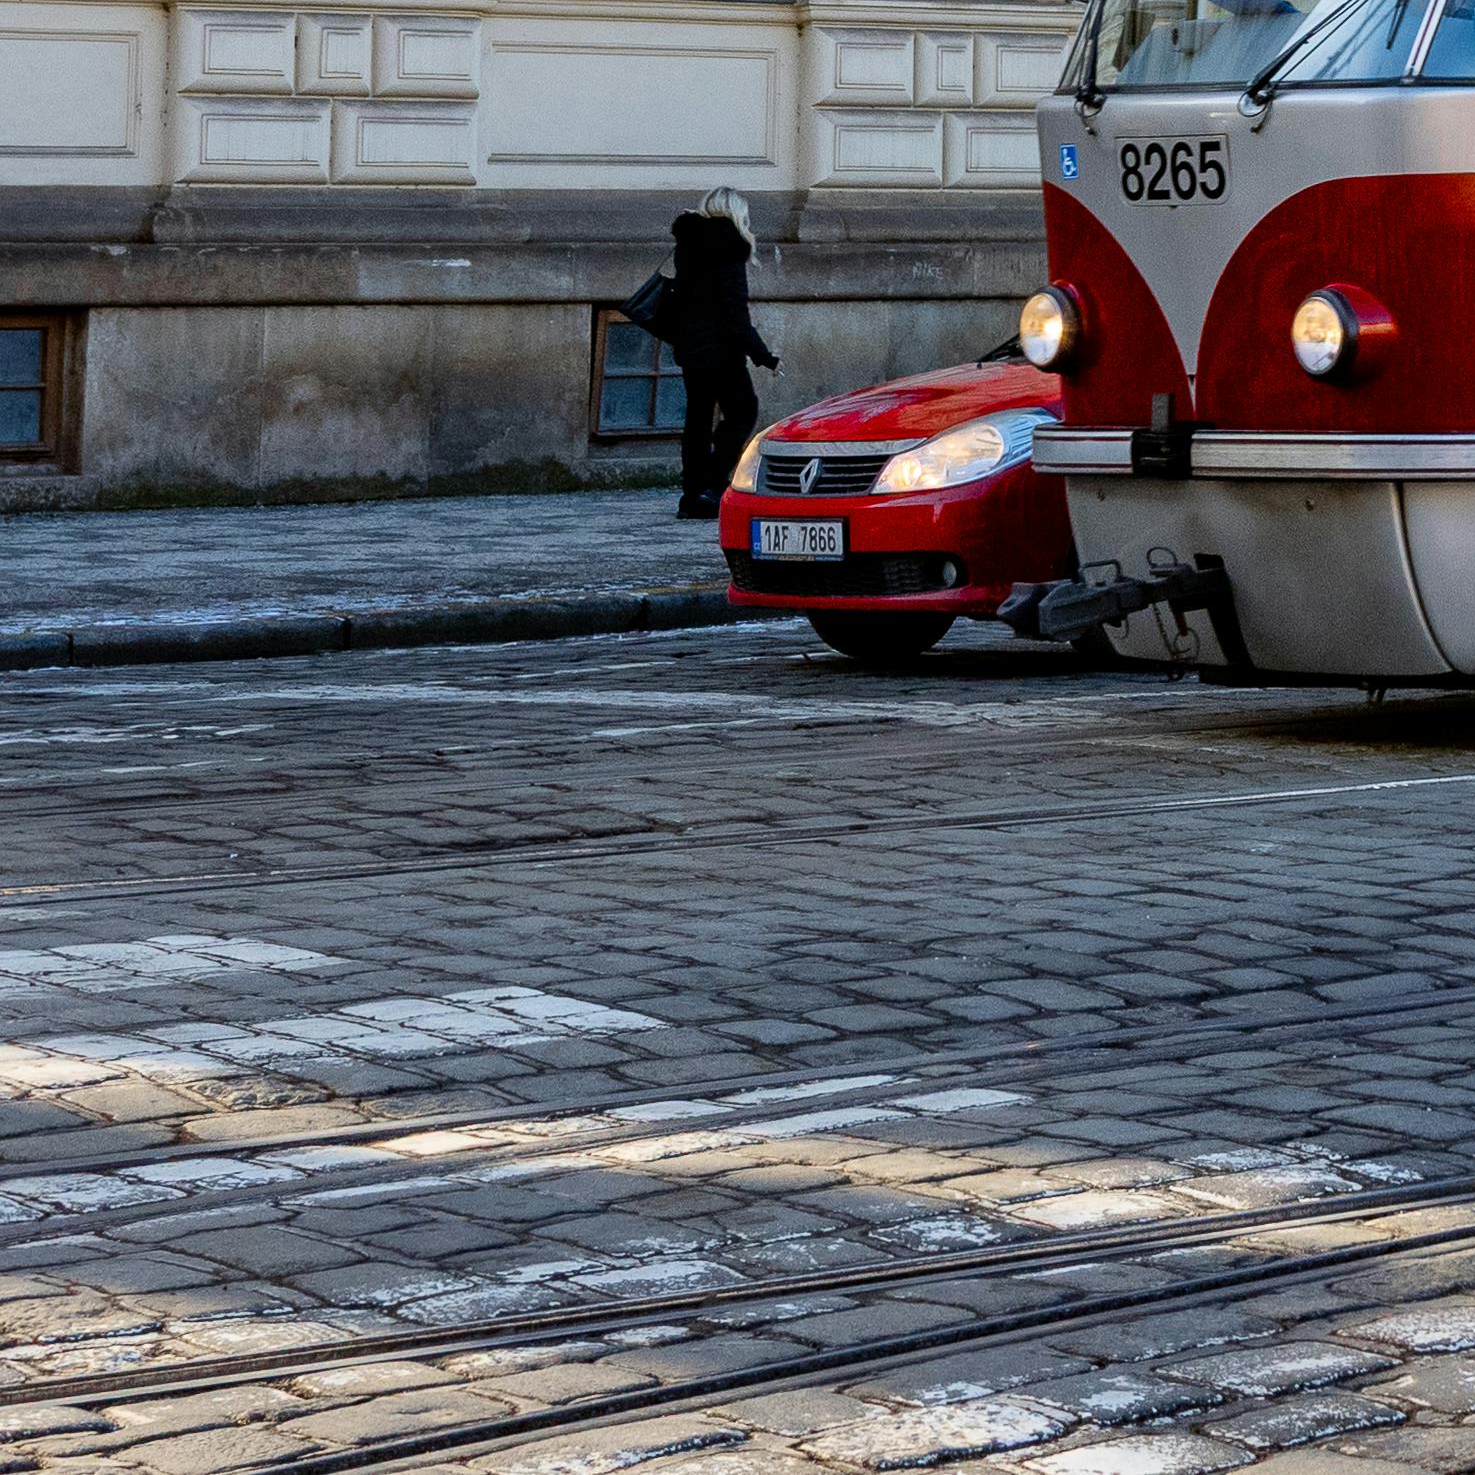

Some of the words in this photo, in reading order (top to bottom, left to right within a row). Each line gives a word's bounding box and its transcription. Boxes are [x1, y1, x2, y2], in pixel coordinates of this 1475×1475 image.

[1120, 140, 1226, 201] 8265
[764, 525, 789, 551] 1AF
[800, 525, 837, 552] 7866
